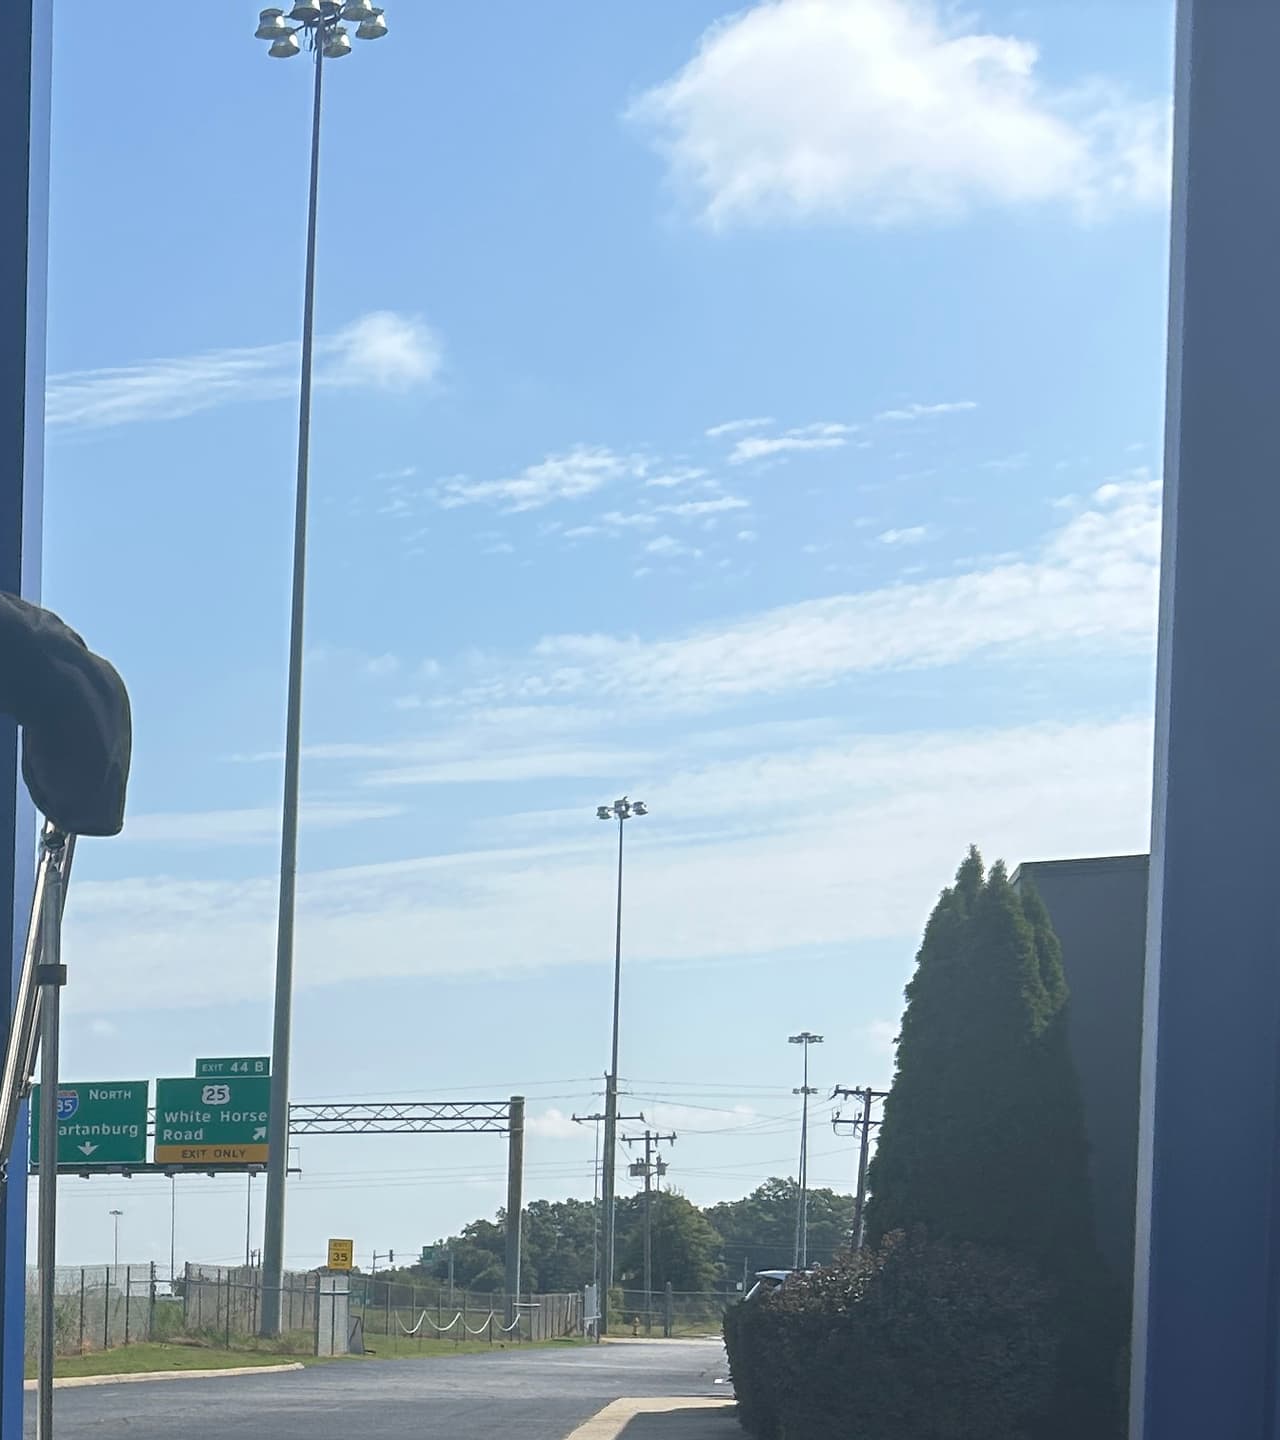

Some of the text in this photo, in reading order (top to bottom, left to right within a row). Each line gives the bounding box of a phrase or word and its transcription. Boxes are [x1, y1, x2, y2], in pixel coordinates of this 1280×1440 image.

[202, 1061, 263, 1072] EXIT 44 B
[206, 1088, 226, 1101] 25
[164, 1111, 268, 1123] White Horse
[58, 1123, 138, 1137] artanburg
[163, 1128, 204, 1141] Road
[182, 1149, 246, 1159] EXIT ONLY
[333, 1252, 348, 1262] 35
